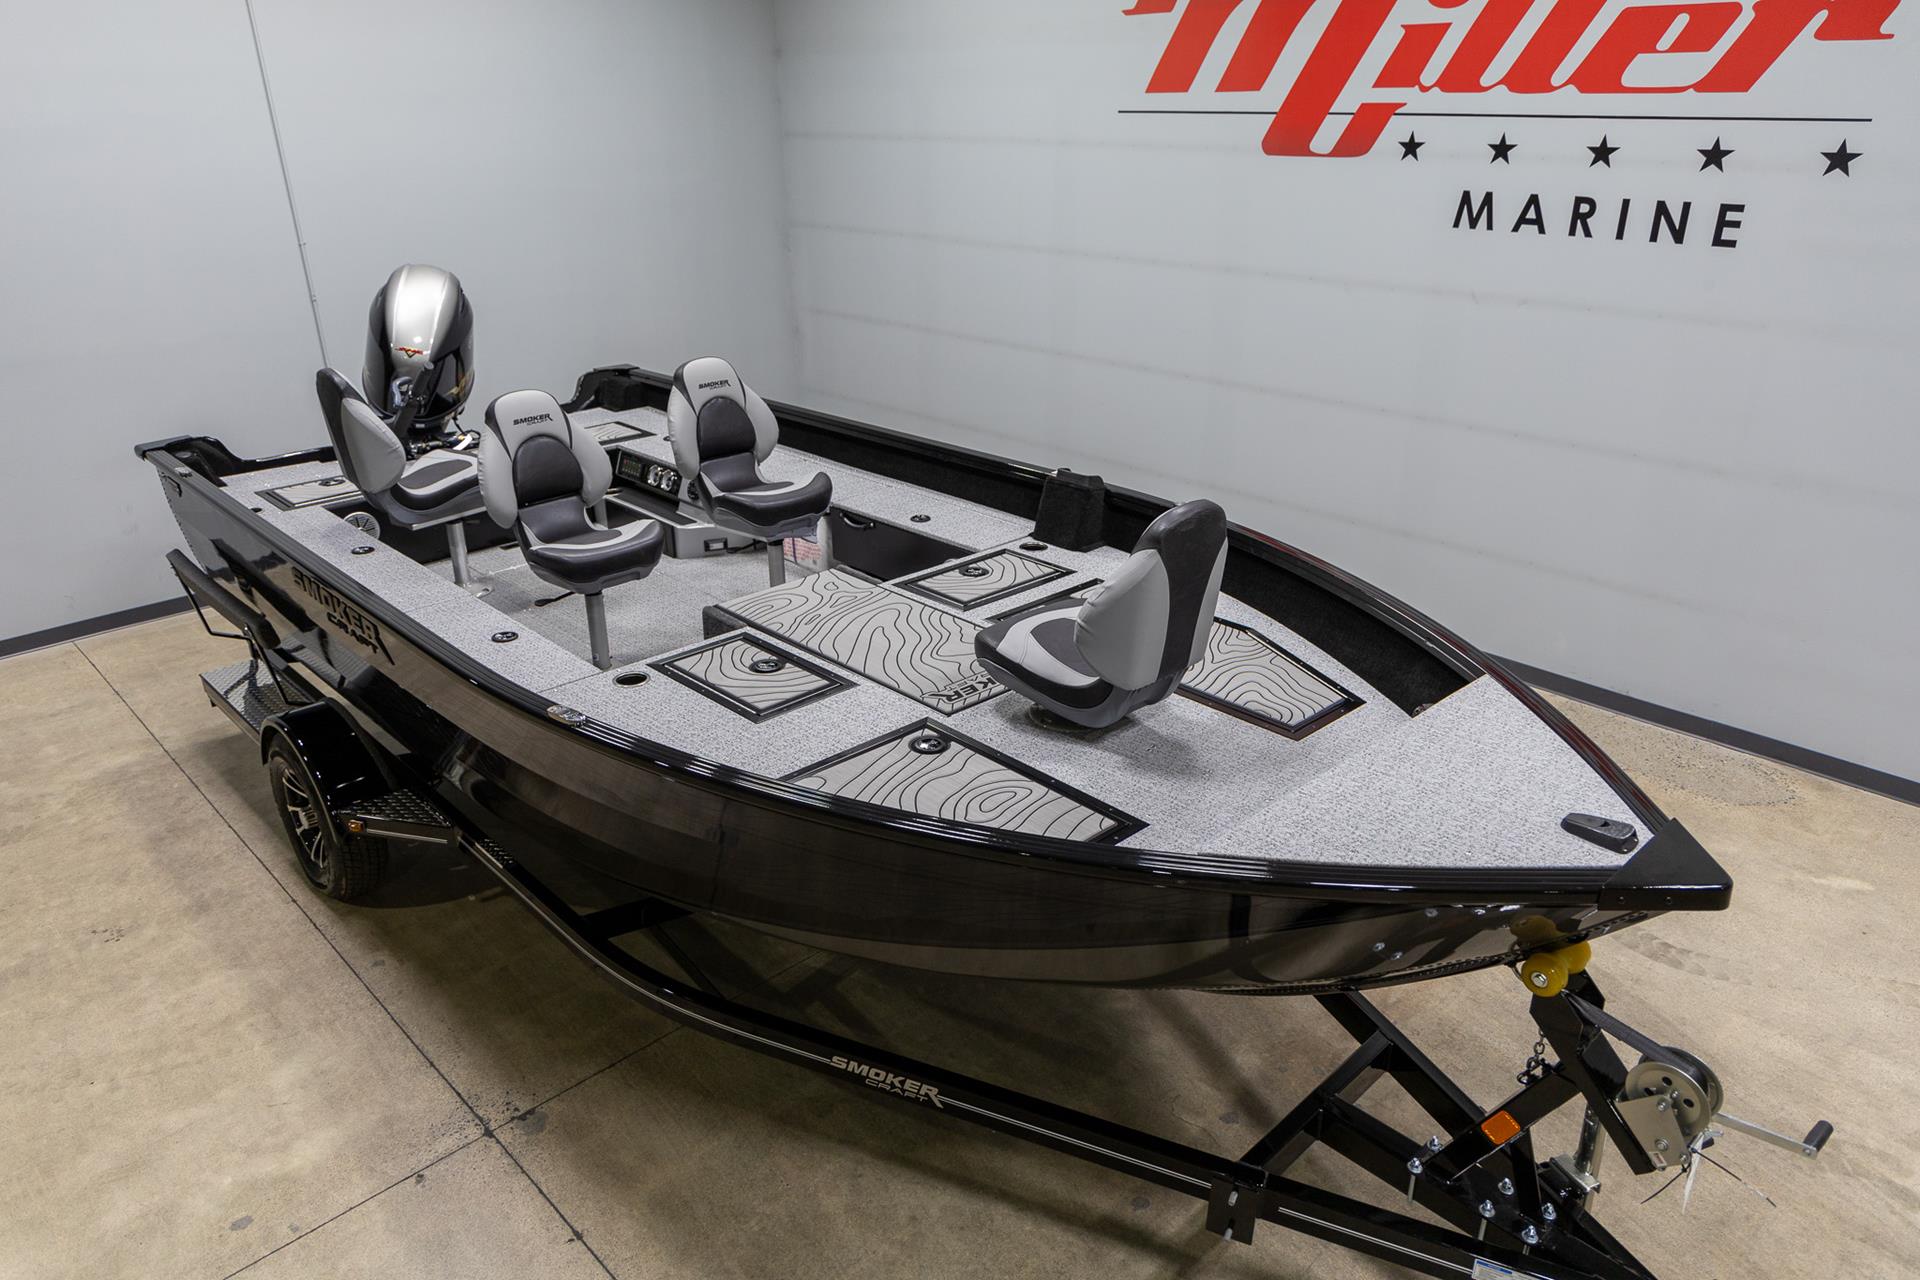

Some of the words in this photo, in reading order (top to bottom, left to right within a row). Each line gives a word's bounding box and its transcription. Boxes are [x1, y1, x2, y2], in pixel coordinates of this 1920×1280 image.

[1452, 189, 1746, 249] MARINE
[513, 413, 553, 425] SMOKER
[928, 677, 997, 701] KER
[830, 1055, 944, 1109] SMOKER
[865, 1078, 928, 1102] CRAFT
